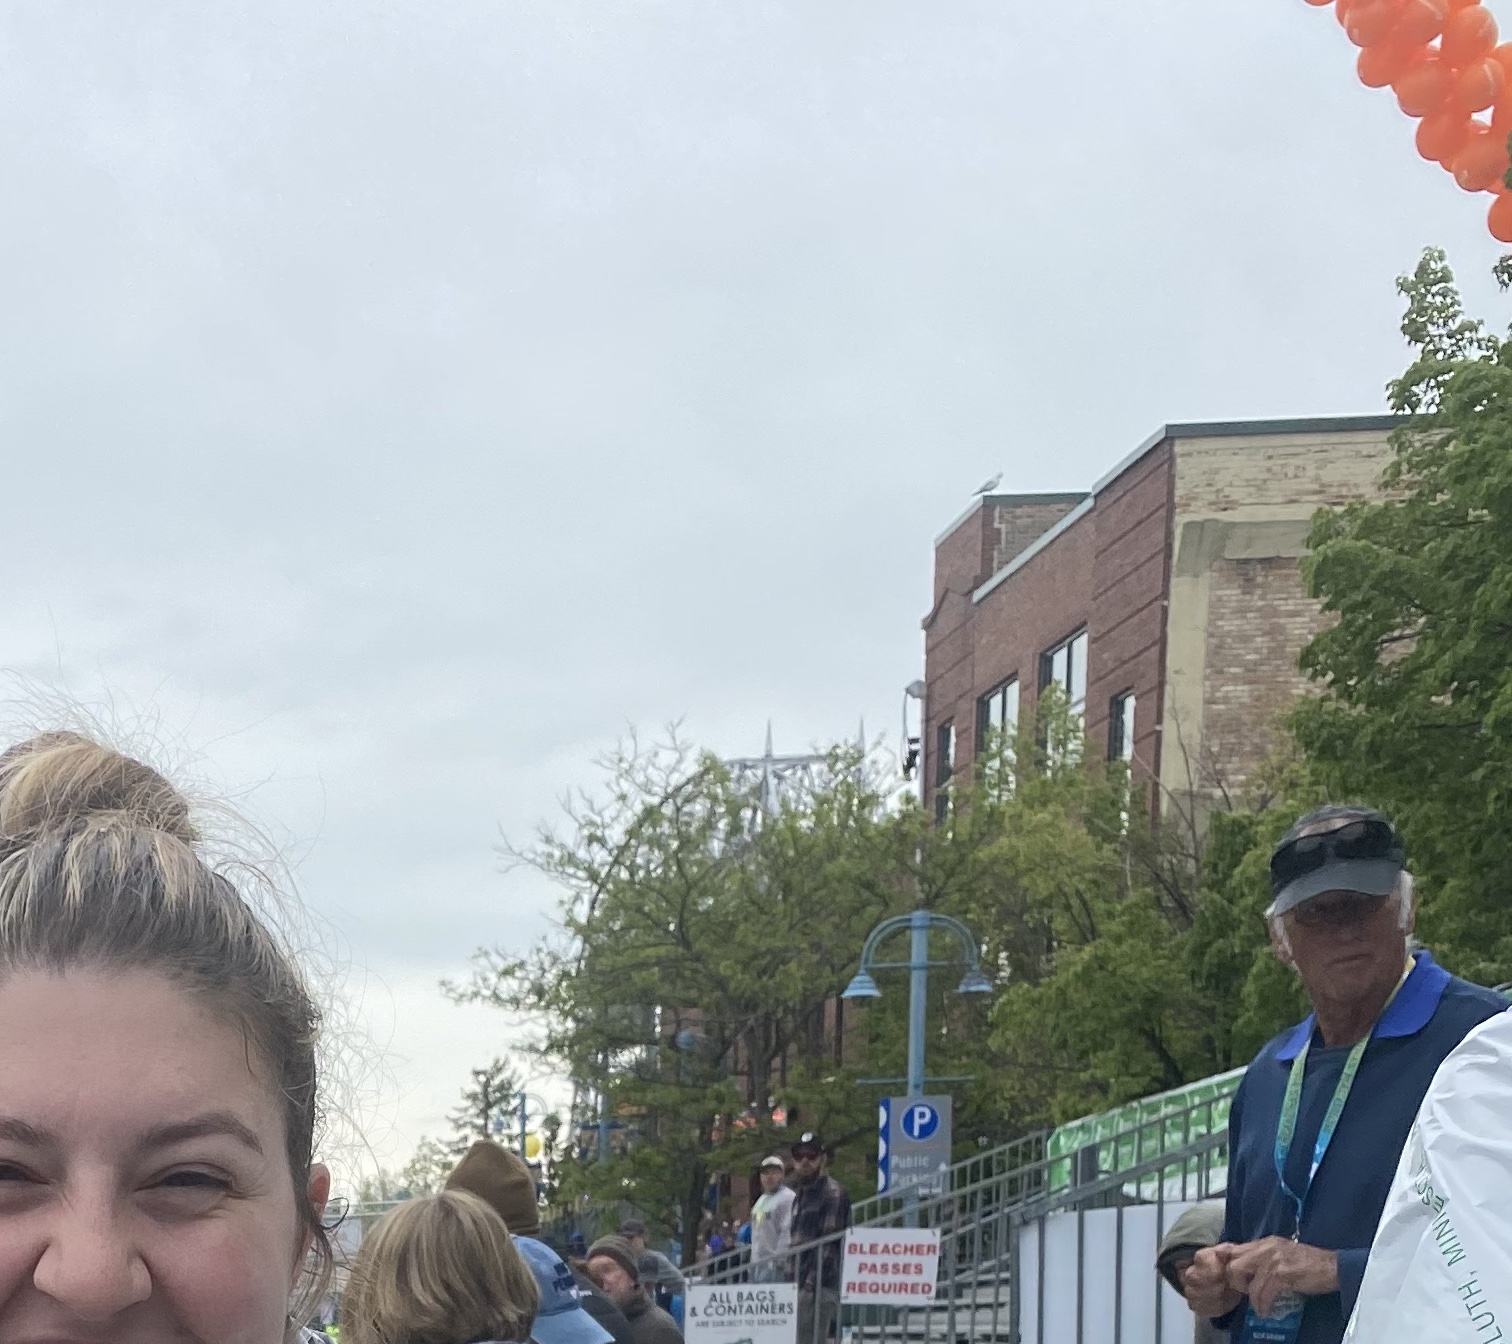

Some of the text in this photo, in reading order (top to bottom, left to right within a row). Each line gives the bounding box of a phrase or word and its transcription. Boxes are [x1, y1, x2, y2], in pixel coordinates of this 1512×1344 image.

[848, 1243, 937, 1256] BLEACHER
[858, 1263, 924, 1275] PASSES
[846, 1282, 933, 1295] REQUIRED
[708, 1290, 776, 1304] ALL BAGS
[703, 1302, 795, 1317] CONTAINERS
